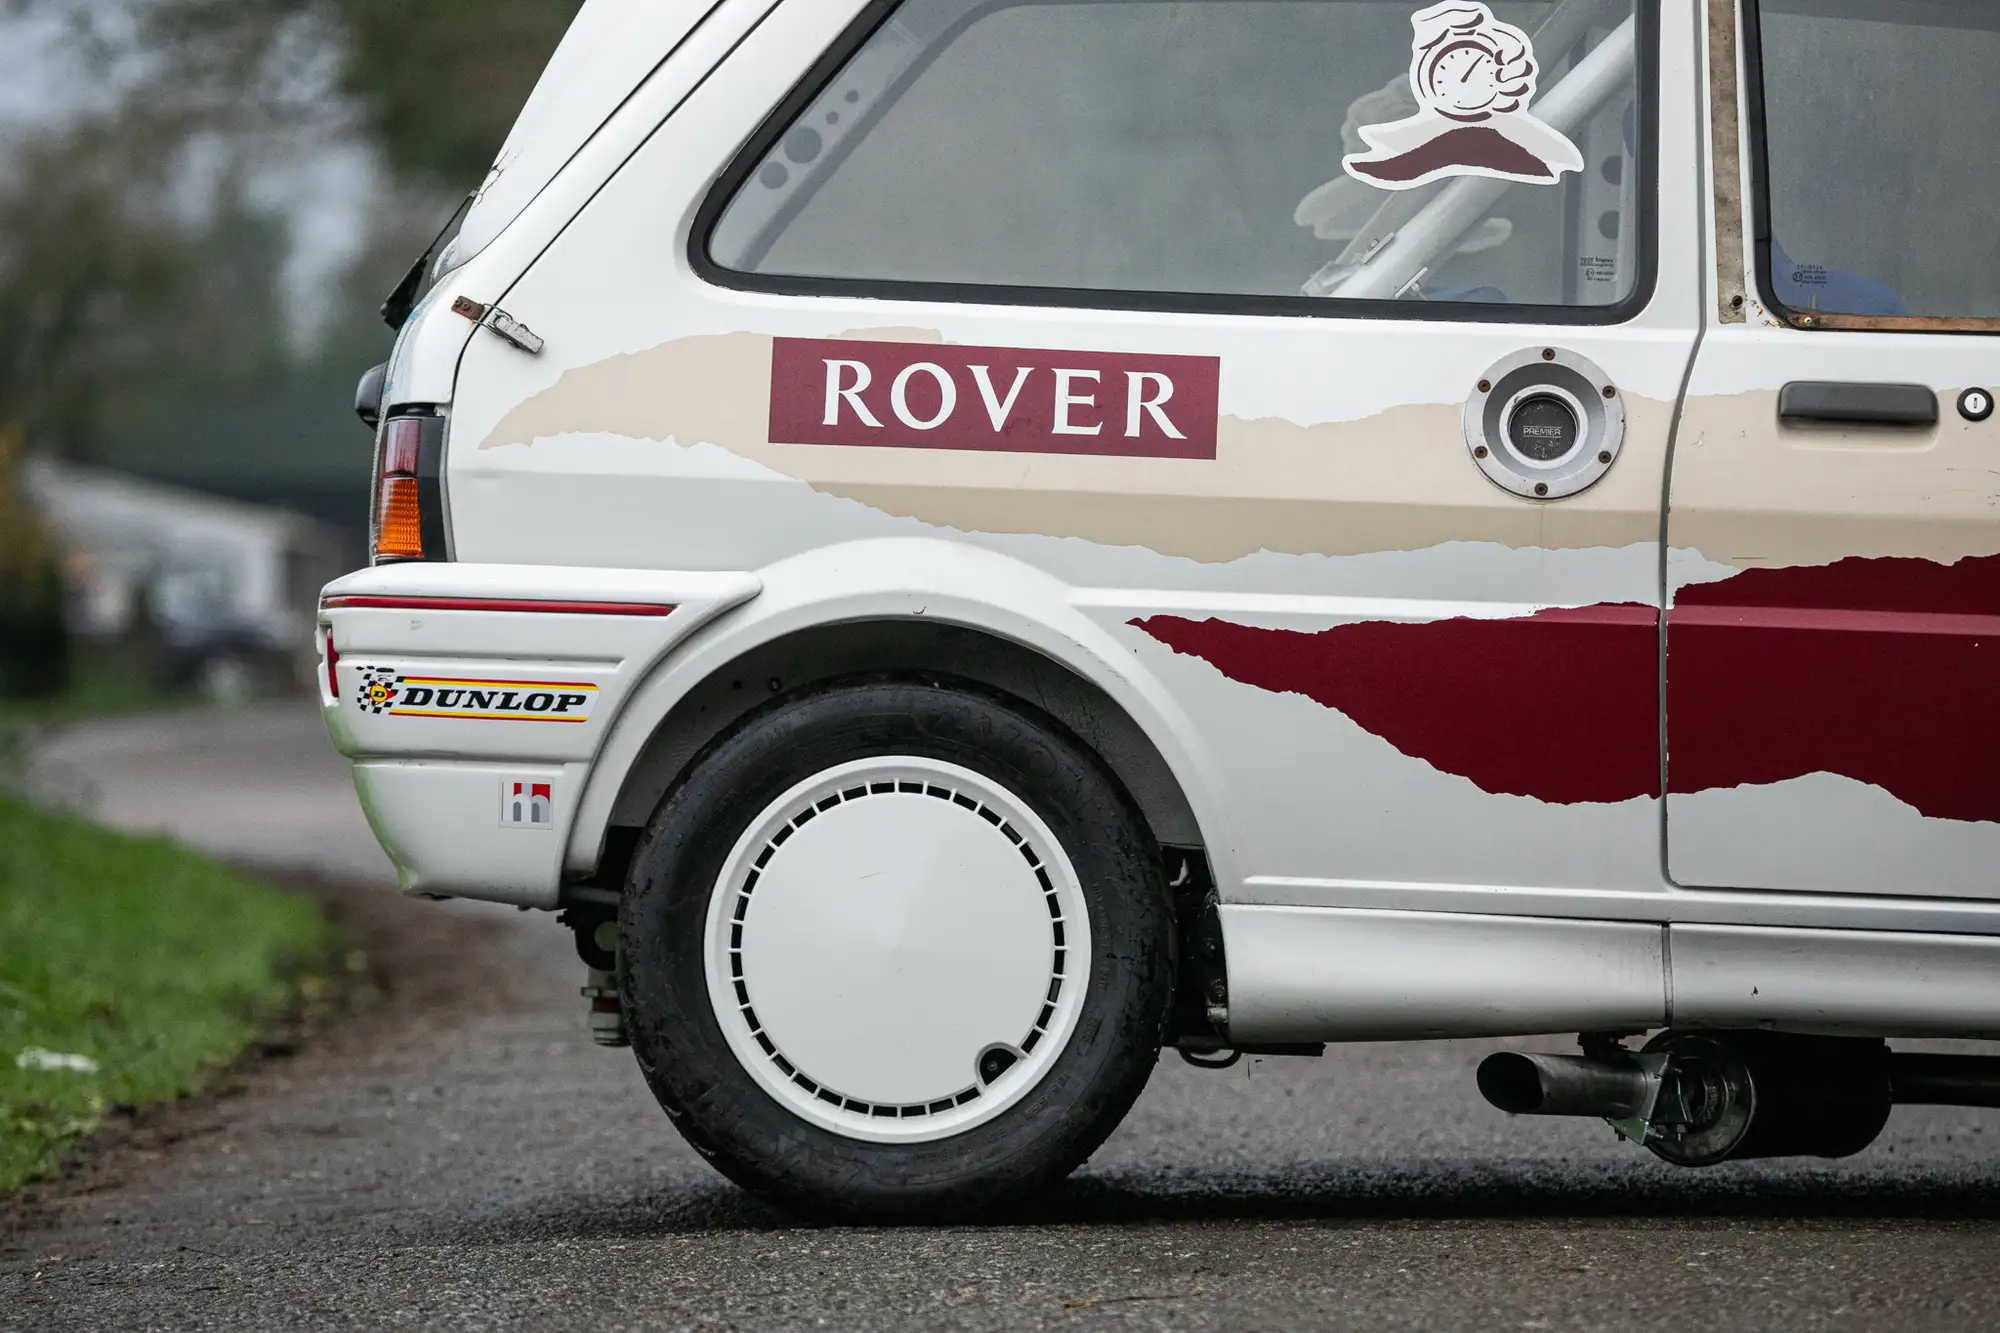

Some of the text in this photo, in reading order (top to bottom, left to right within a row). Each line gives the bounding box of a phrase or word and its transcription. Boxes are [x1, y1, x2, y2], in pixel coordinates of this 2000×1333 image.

[821, 358, 1188, 440] ROVER
[1522, 427, 1561, 436] PREMIER
[373, 690, 386, 698] D
[400, 687, 587, 713] DUNLOP
